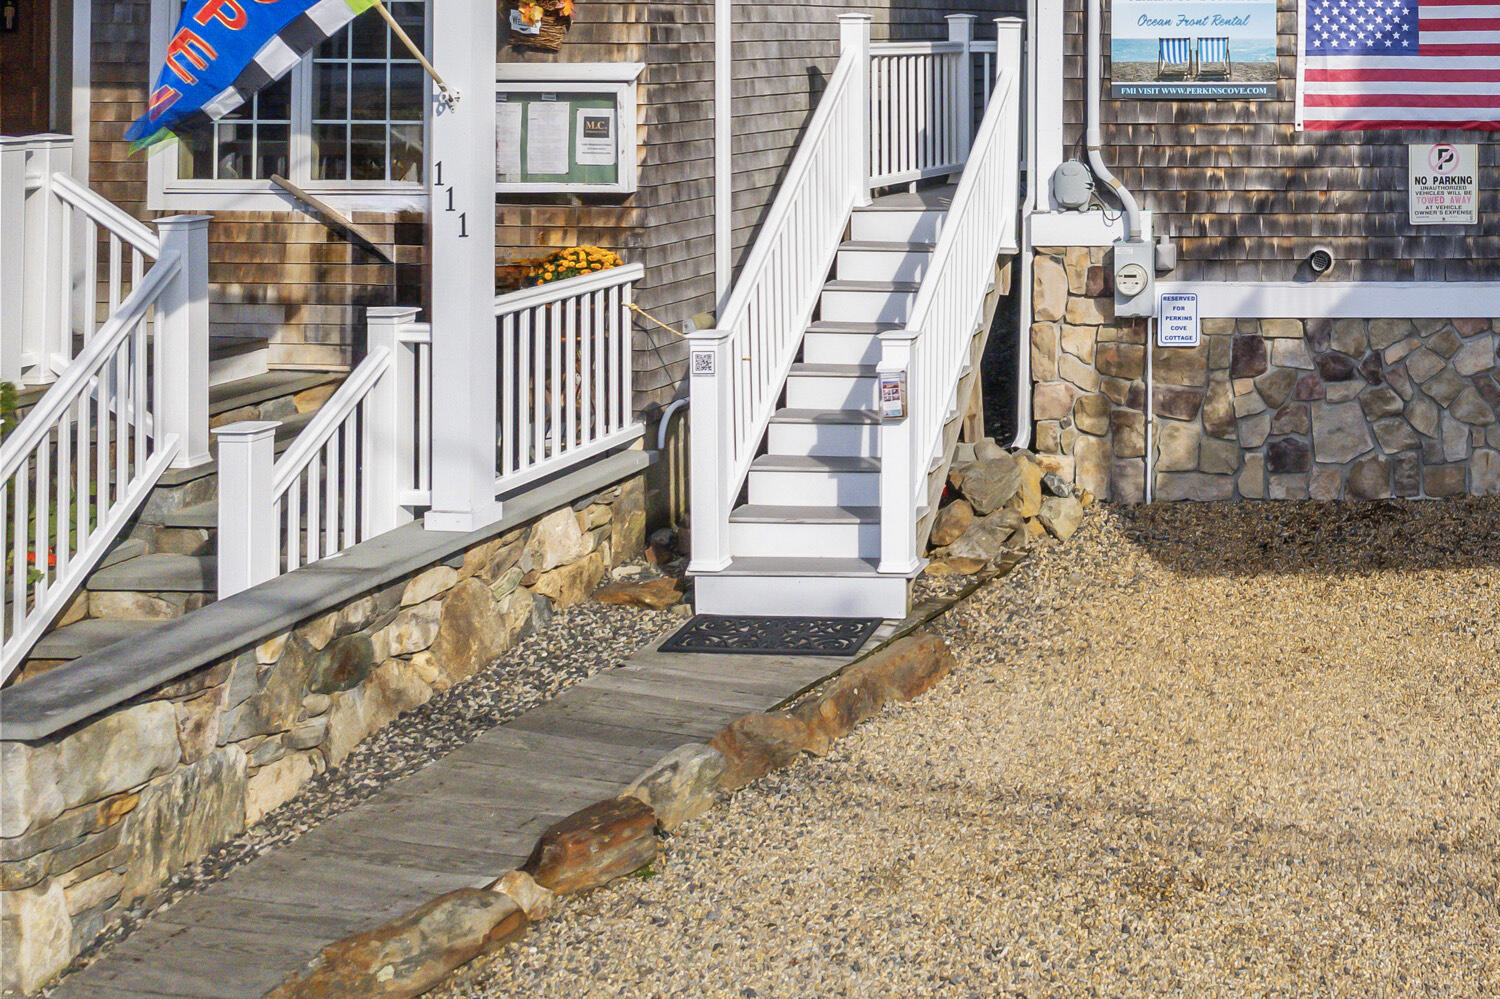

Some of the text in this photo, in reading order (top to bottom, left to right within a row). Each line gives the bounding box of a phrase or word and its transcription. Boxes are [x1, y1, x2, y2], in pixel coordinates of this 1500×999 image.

[1137, 13, 1251, 26] Ocean Front Rental
[1121, 87, 1267, 95] FMI VISIT WWW.PERKINSCOVE.COM
[1414, 176, 1472, 185] NO PARKING
[434, 161, 469, 237] 111
[1416, 196, 1471, 204] TOWED AWAY
